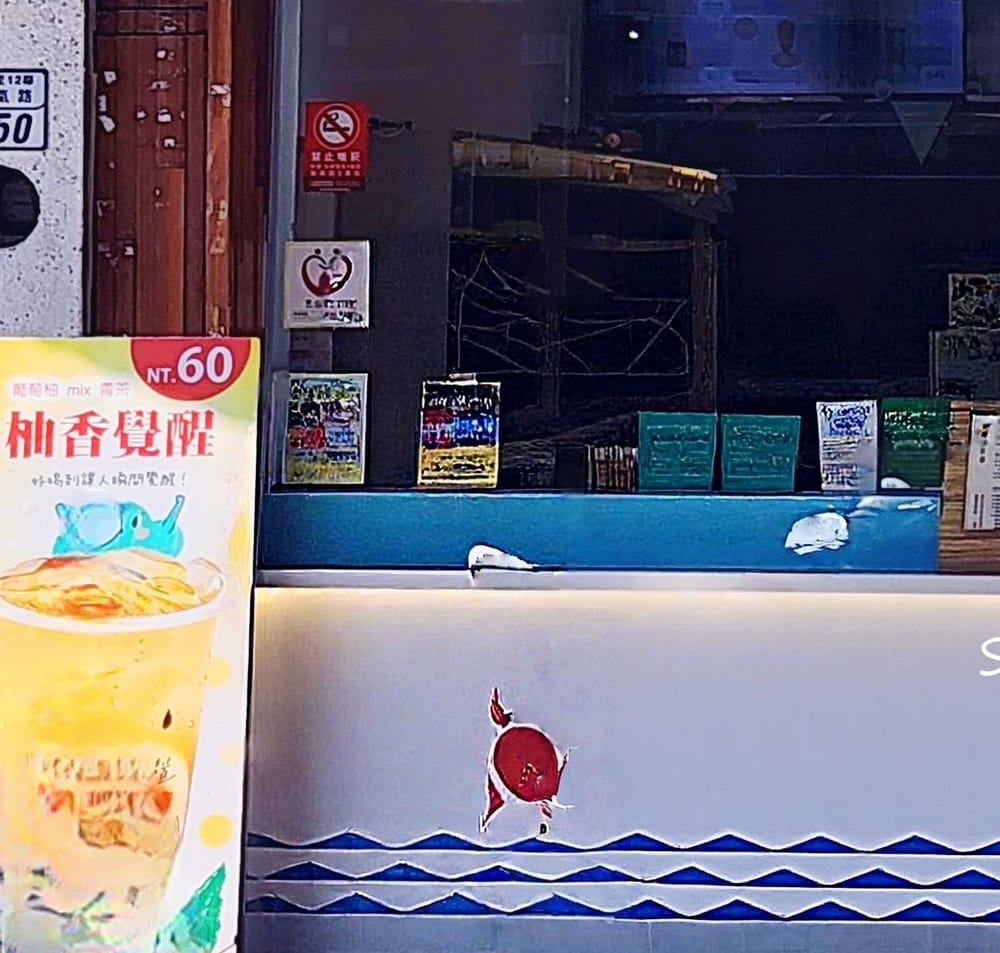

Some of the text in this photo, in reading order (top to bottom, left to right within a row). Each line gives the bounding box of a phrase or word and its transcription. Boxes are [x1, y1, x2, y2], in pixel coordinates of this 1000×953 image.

[147, 346, 234, 385] NT.60
[12, 382, 59, 398] 葡萄柚
[67, 384, 91, 397] mix
[6, 409, 216, 460] 柚香覺醒
